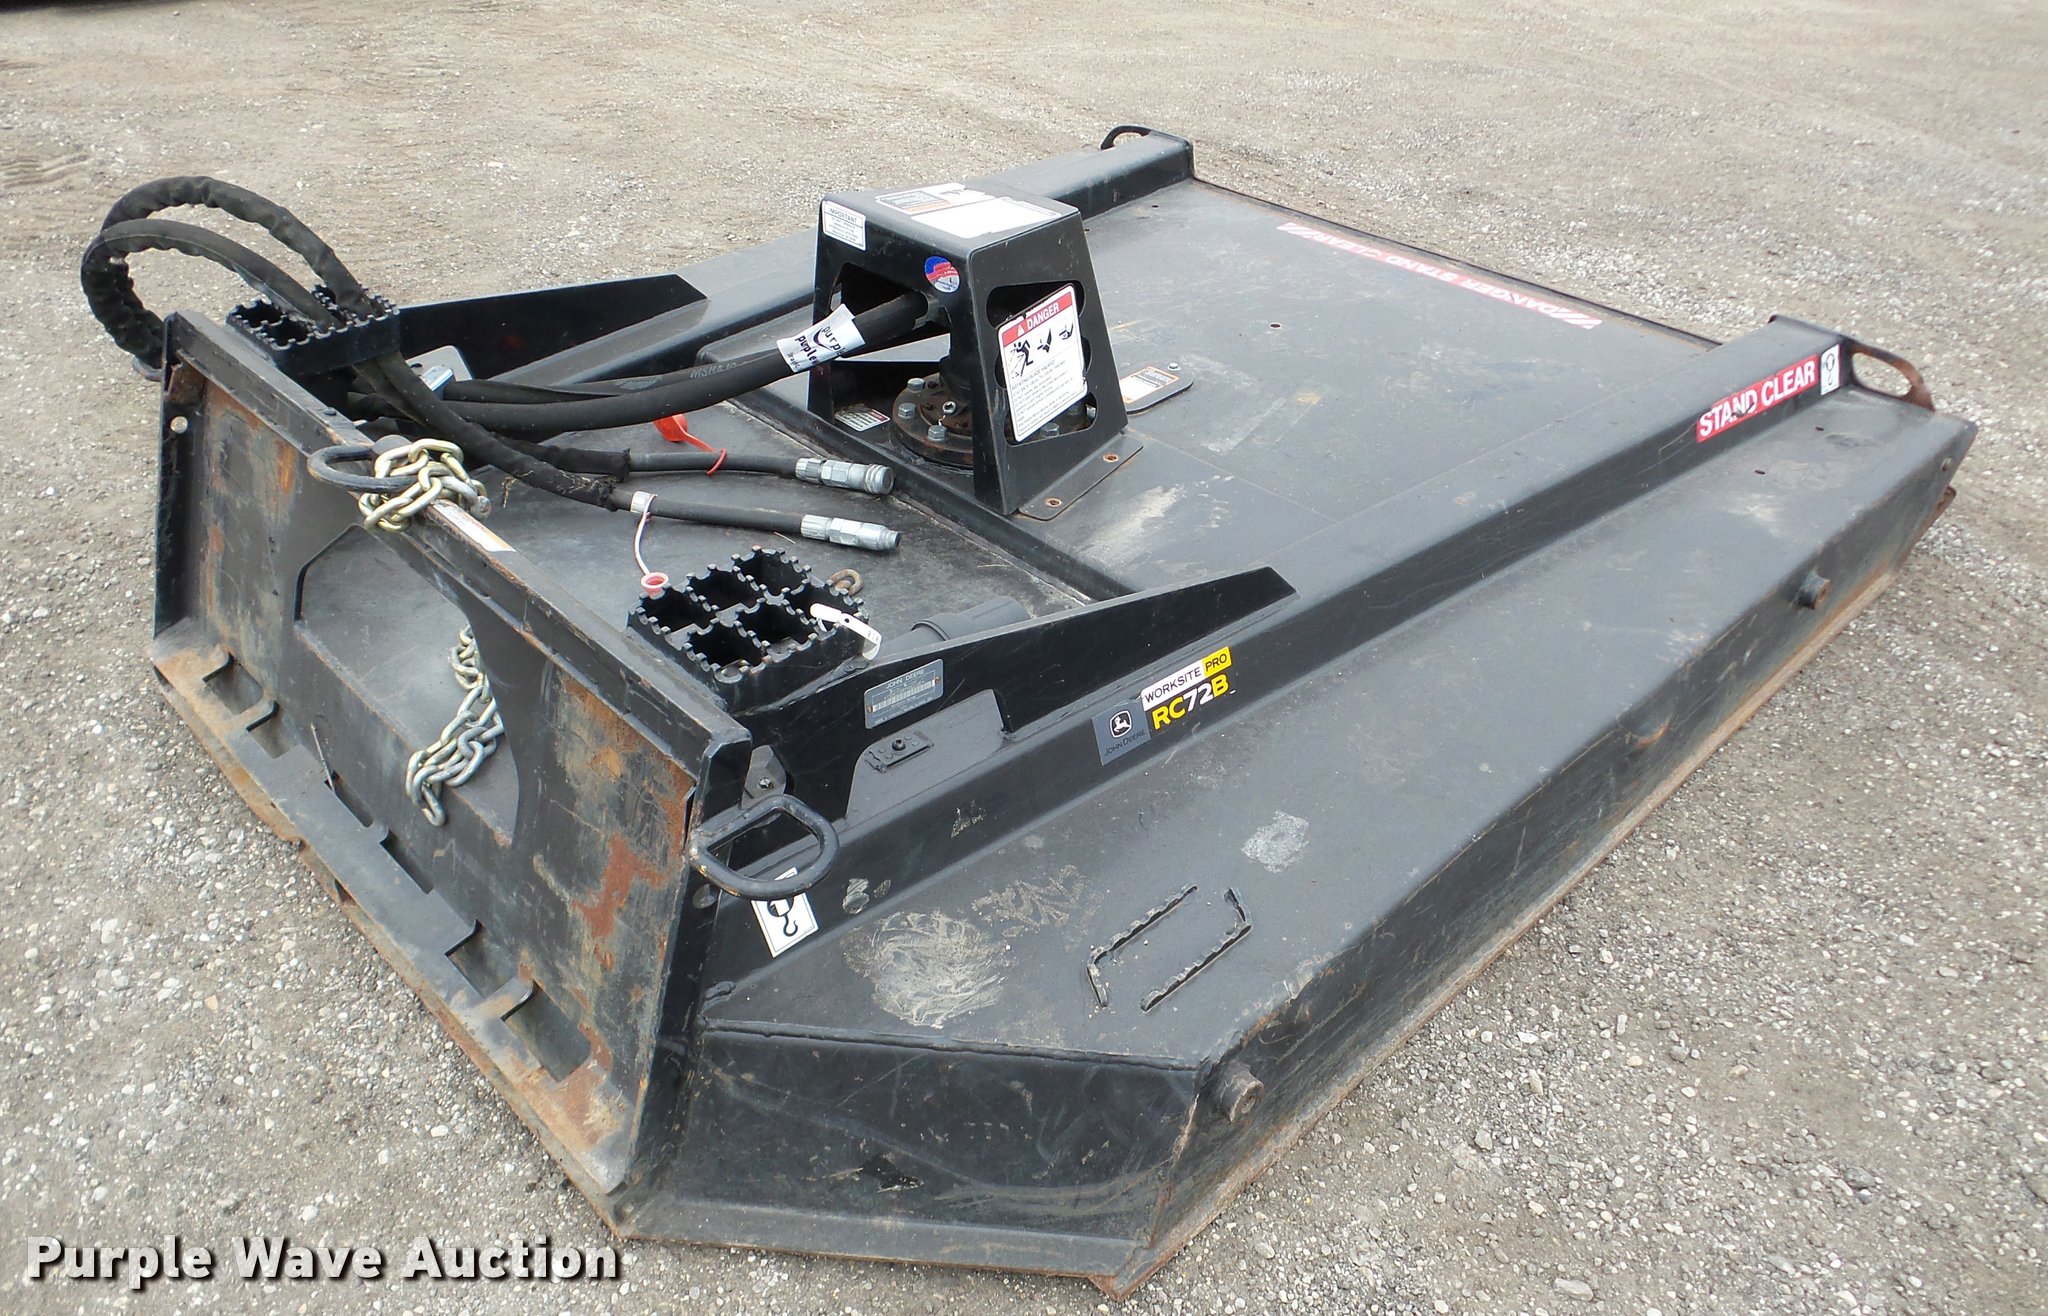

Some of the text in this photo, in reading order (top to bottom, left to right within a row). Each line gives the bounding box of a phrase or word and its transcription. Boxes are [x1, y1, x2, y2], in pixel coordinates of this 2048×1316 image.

[1384, 255, 1459, 283] STAND
[1460, 278, 1558, 317] DANGER
[1026, 302, 1060, 331] DANGER
[1699, 360, 1817, 438] STAND CLEAR
[886, 669, 925, 690] JOHN DEERE
[1144, 653, 1228, 704] WORKSITE PRO
[1152, 673, 1230, 730] RC72B
[1104, 730, 1146, 757] JOHN DEERE
